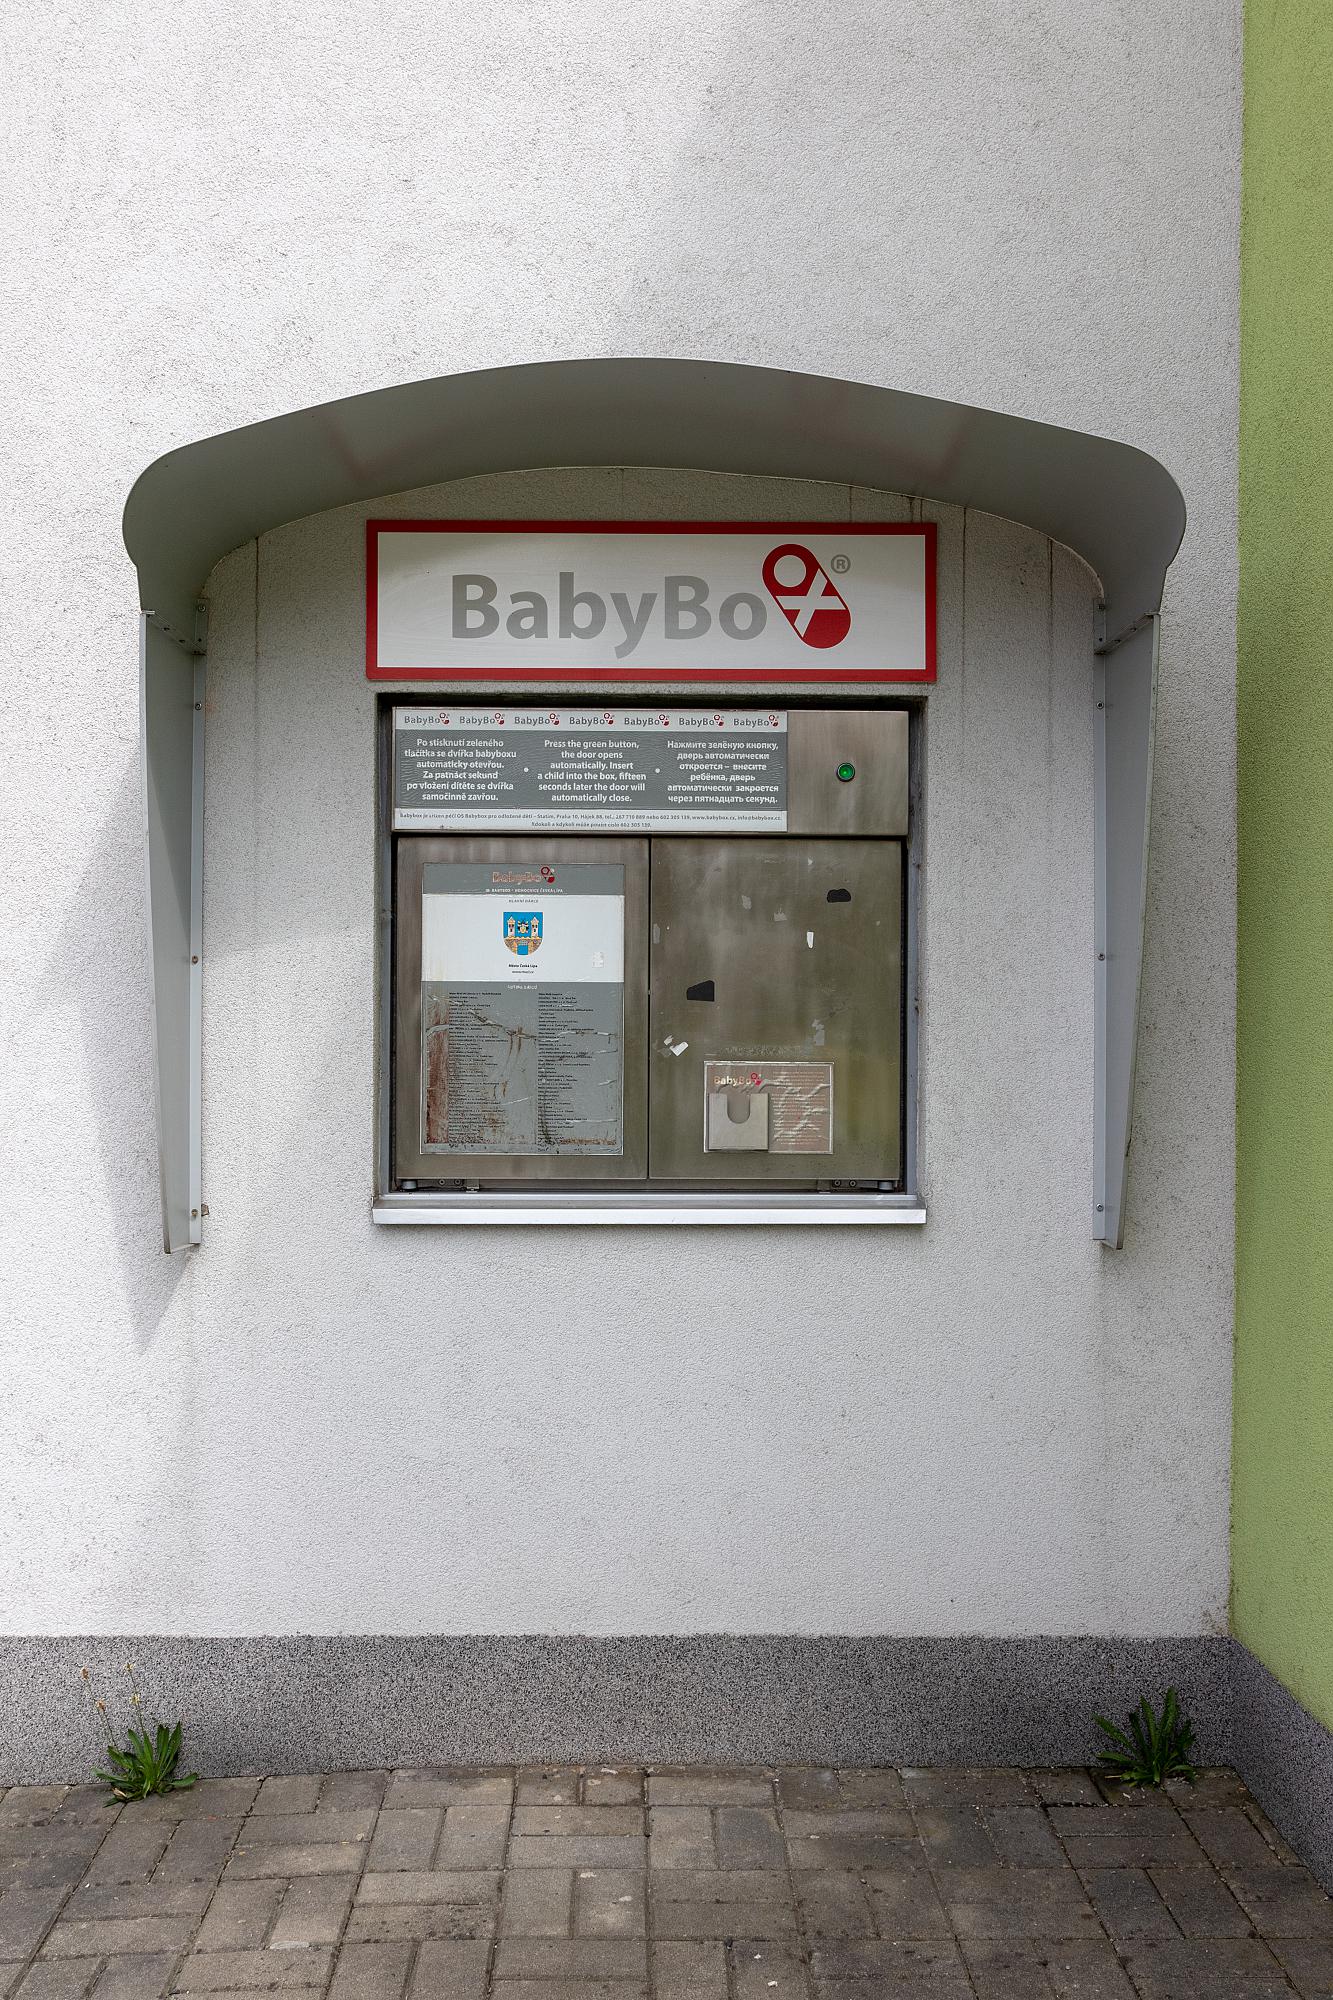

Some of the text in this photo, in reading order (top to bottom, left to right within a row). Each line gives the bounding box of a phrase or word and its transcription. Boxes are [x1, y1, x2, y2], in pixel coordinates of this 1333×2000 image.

[544, 740, 565, 748] Press
[568, 740, 581, 748] the
[609, 740, 639, 748] button,
[708, 741, 744, 750] зелёную
[746, 742, 778, 750] кнопку,
[476, 750, 516, 759] babyboxu
[598, 752, 622, 760] opens
[417, 761, 467, 769] automaticky
[550, 762, 608, 770] automatically.
[435, 771, 466, 780] patnáct
[469, 771, 498, 779] sekund
[544, 772, 564, 780] child
[566, 772, 582, 780] into
[584, 772, 598, 780] the
[600, 772, 617, 780] box,
[619, 772, 646, 780] fifteen
[691, 773, 728, 781] ребёнка,
[631, 783, 645, 791] will
[736, 785, 779, 793] закроется
[552, 794, 607, 803] automatically
[746, 796, 777, 804] секунд.
